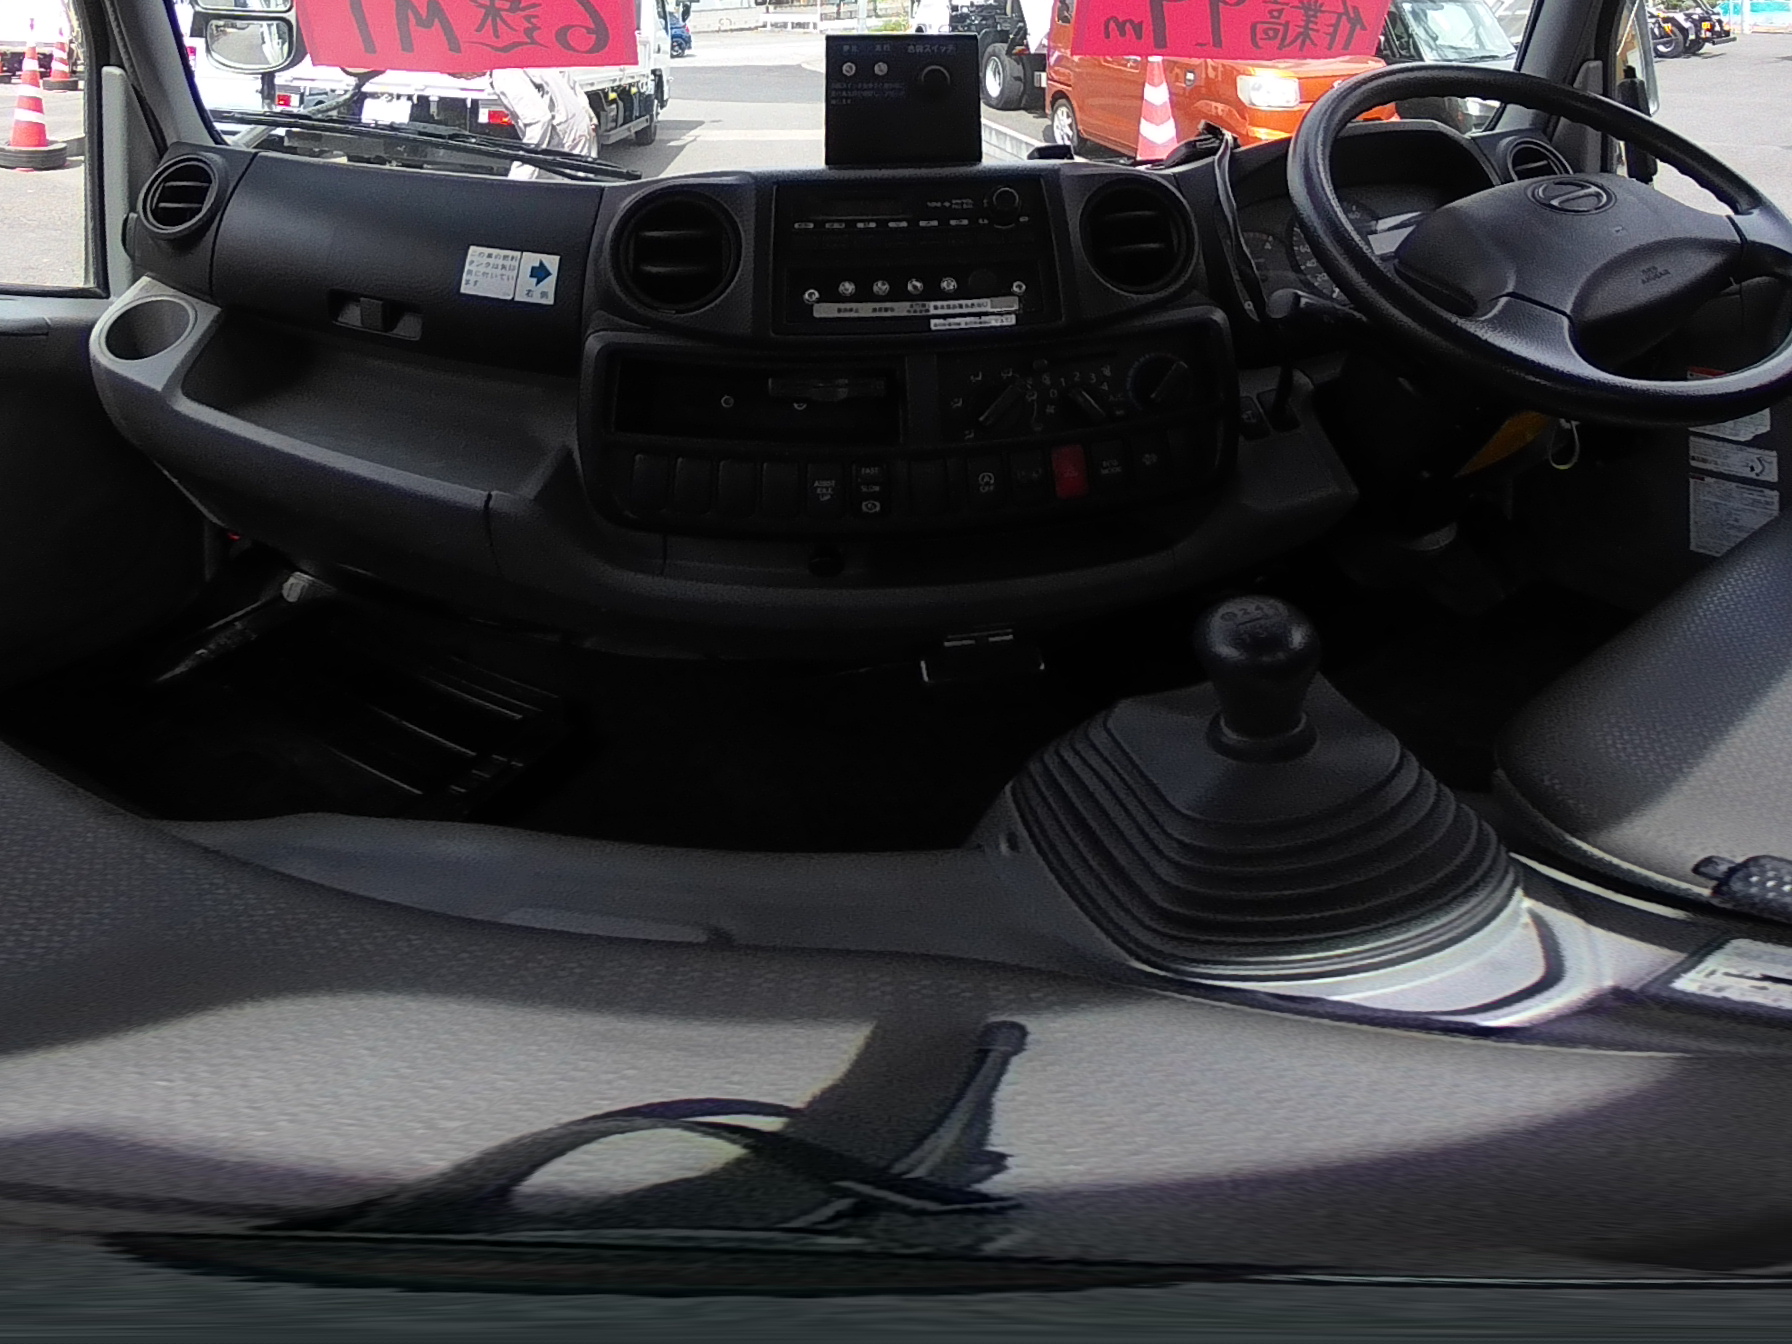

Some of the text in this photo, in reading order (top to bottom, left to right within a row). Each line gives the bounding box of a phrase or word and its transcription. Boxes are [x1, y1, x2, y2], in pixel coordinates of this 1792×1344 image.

[1073, 372, 1081, 382] 2
[1089, 373, 1097, 384] 3
[861, 467, 879, 475] FAST
